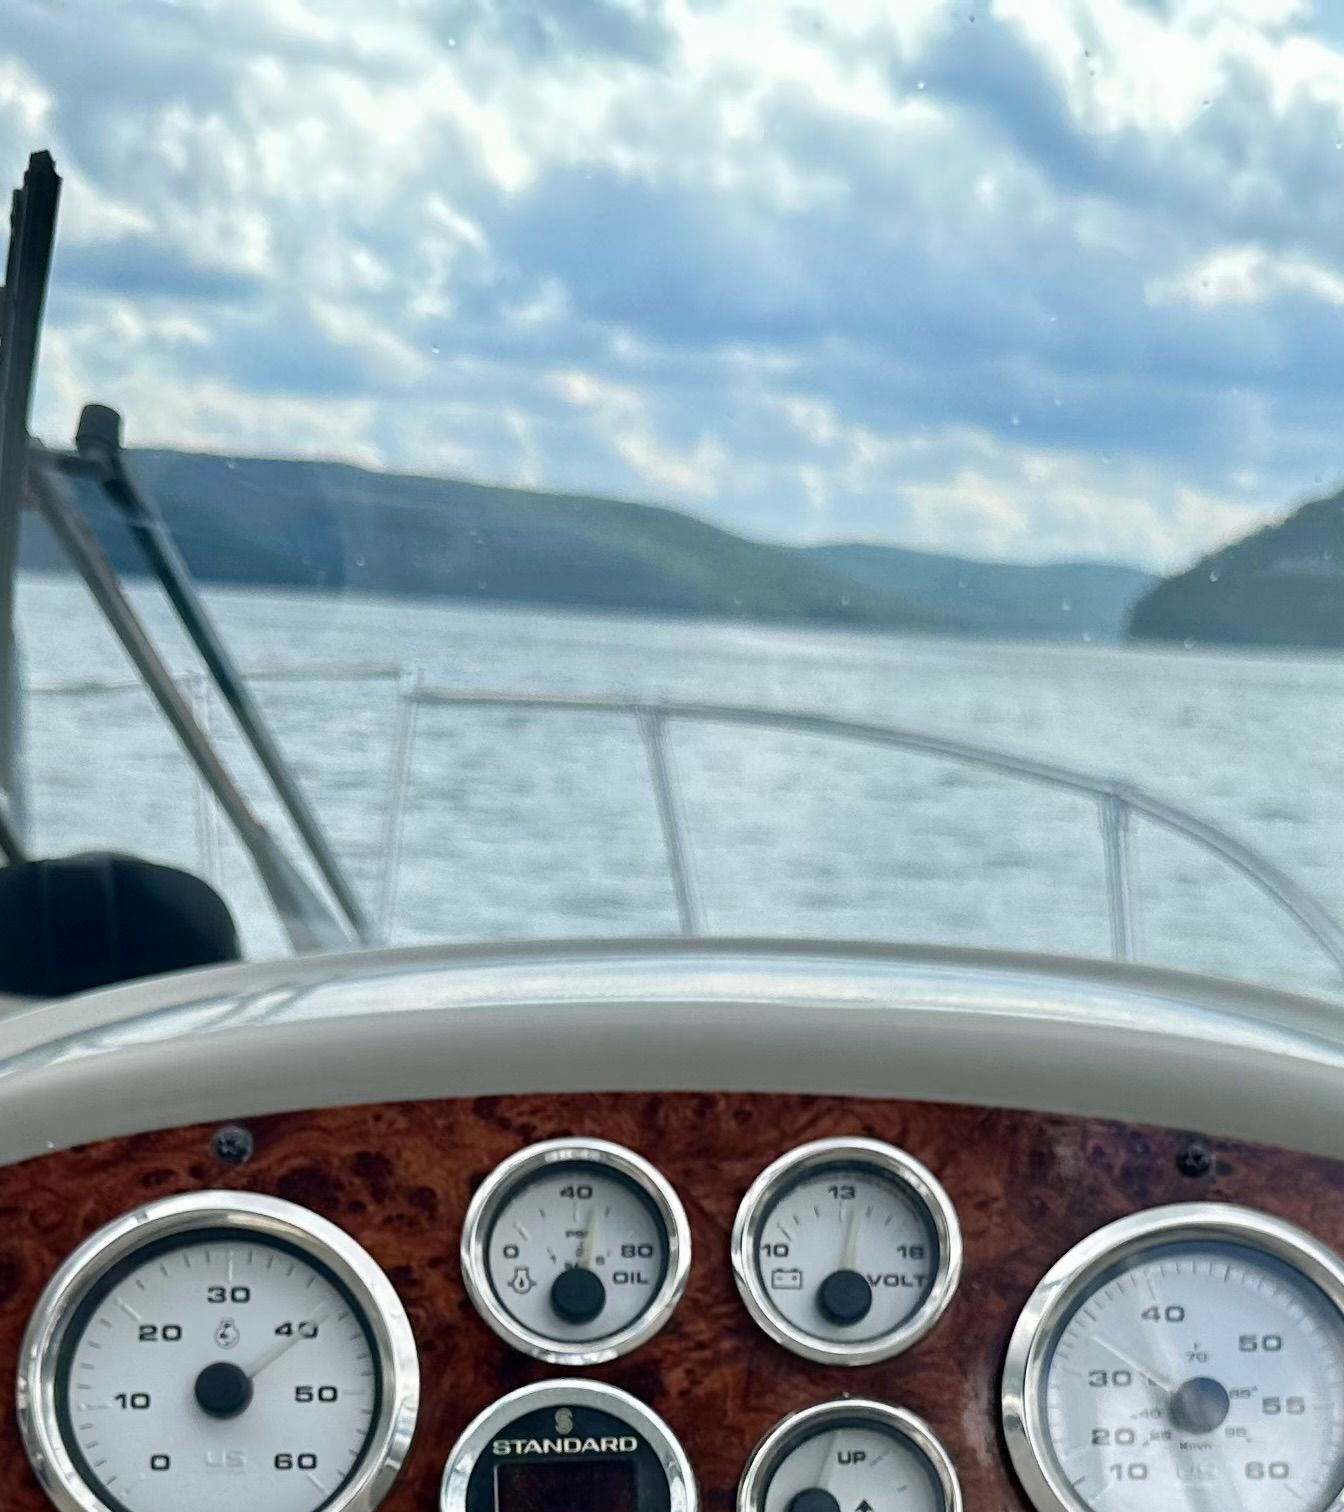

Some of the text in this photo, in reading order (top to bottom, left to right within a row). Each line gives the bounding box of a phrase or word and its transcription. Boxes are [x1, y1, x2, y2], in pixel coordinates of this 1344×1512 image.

[560, 1186, 593, 1199] 40
[828, 1186, 855, 1199] 13
[503, 1244, 519, 1259] 0
[621, 1244, 654, 1258] 80
[761, 1244, 789, 1258] 10
[612, 1272, 649, 1285] OIL
[866, 1273, 927, 1288] VOLT
[207, 1286, 251, 1304] 30
[1140, 1306, 1185, 1323] 40
[138, 1324, 182, 1342] 20
[274, 1322, 319, 1339] 40
[1238, 1335, 1282, 1352] 50
[1088, 1371, 1131, 1388] 30
[114, 1392, 151, 1410] 10
[295, 1386, 338, 1403] 50
[1262, 1398, 1305, 1415] 55
[493, 1436, 638, 1455] STANDARD
[1091, 1429, 1135, 1446] 20
[150, 1454, 171, 1471] 0
[274, 1453, 317, 1470] 60
[837, 1451, 866, 1465] UP
[1109, 1462, 1148, 1480] 10
[1244, 1461, 1289, 1480] 60
